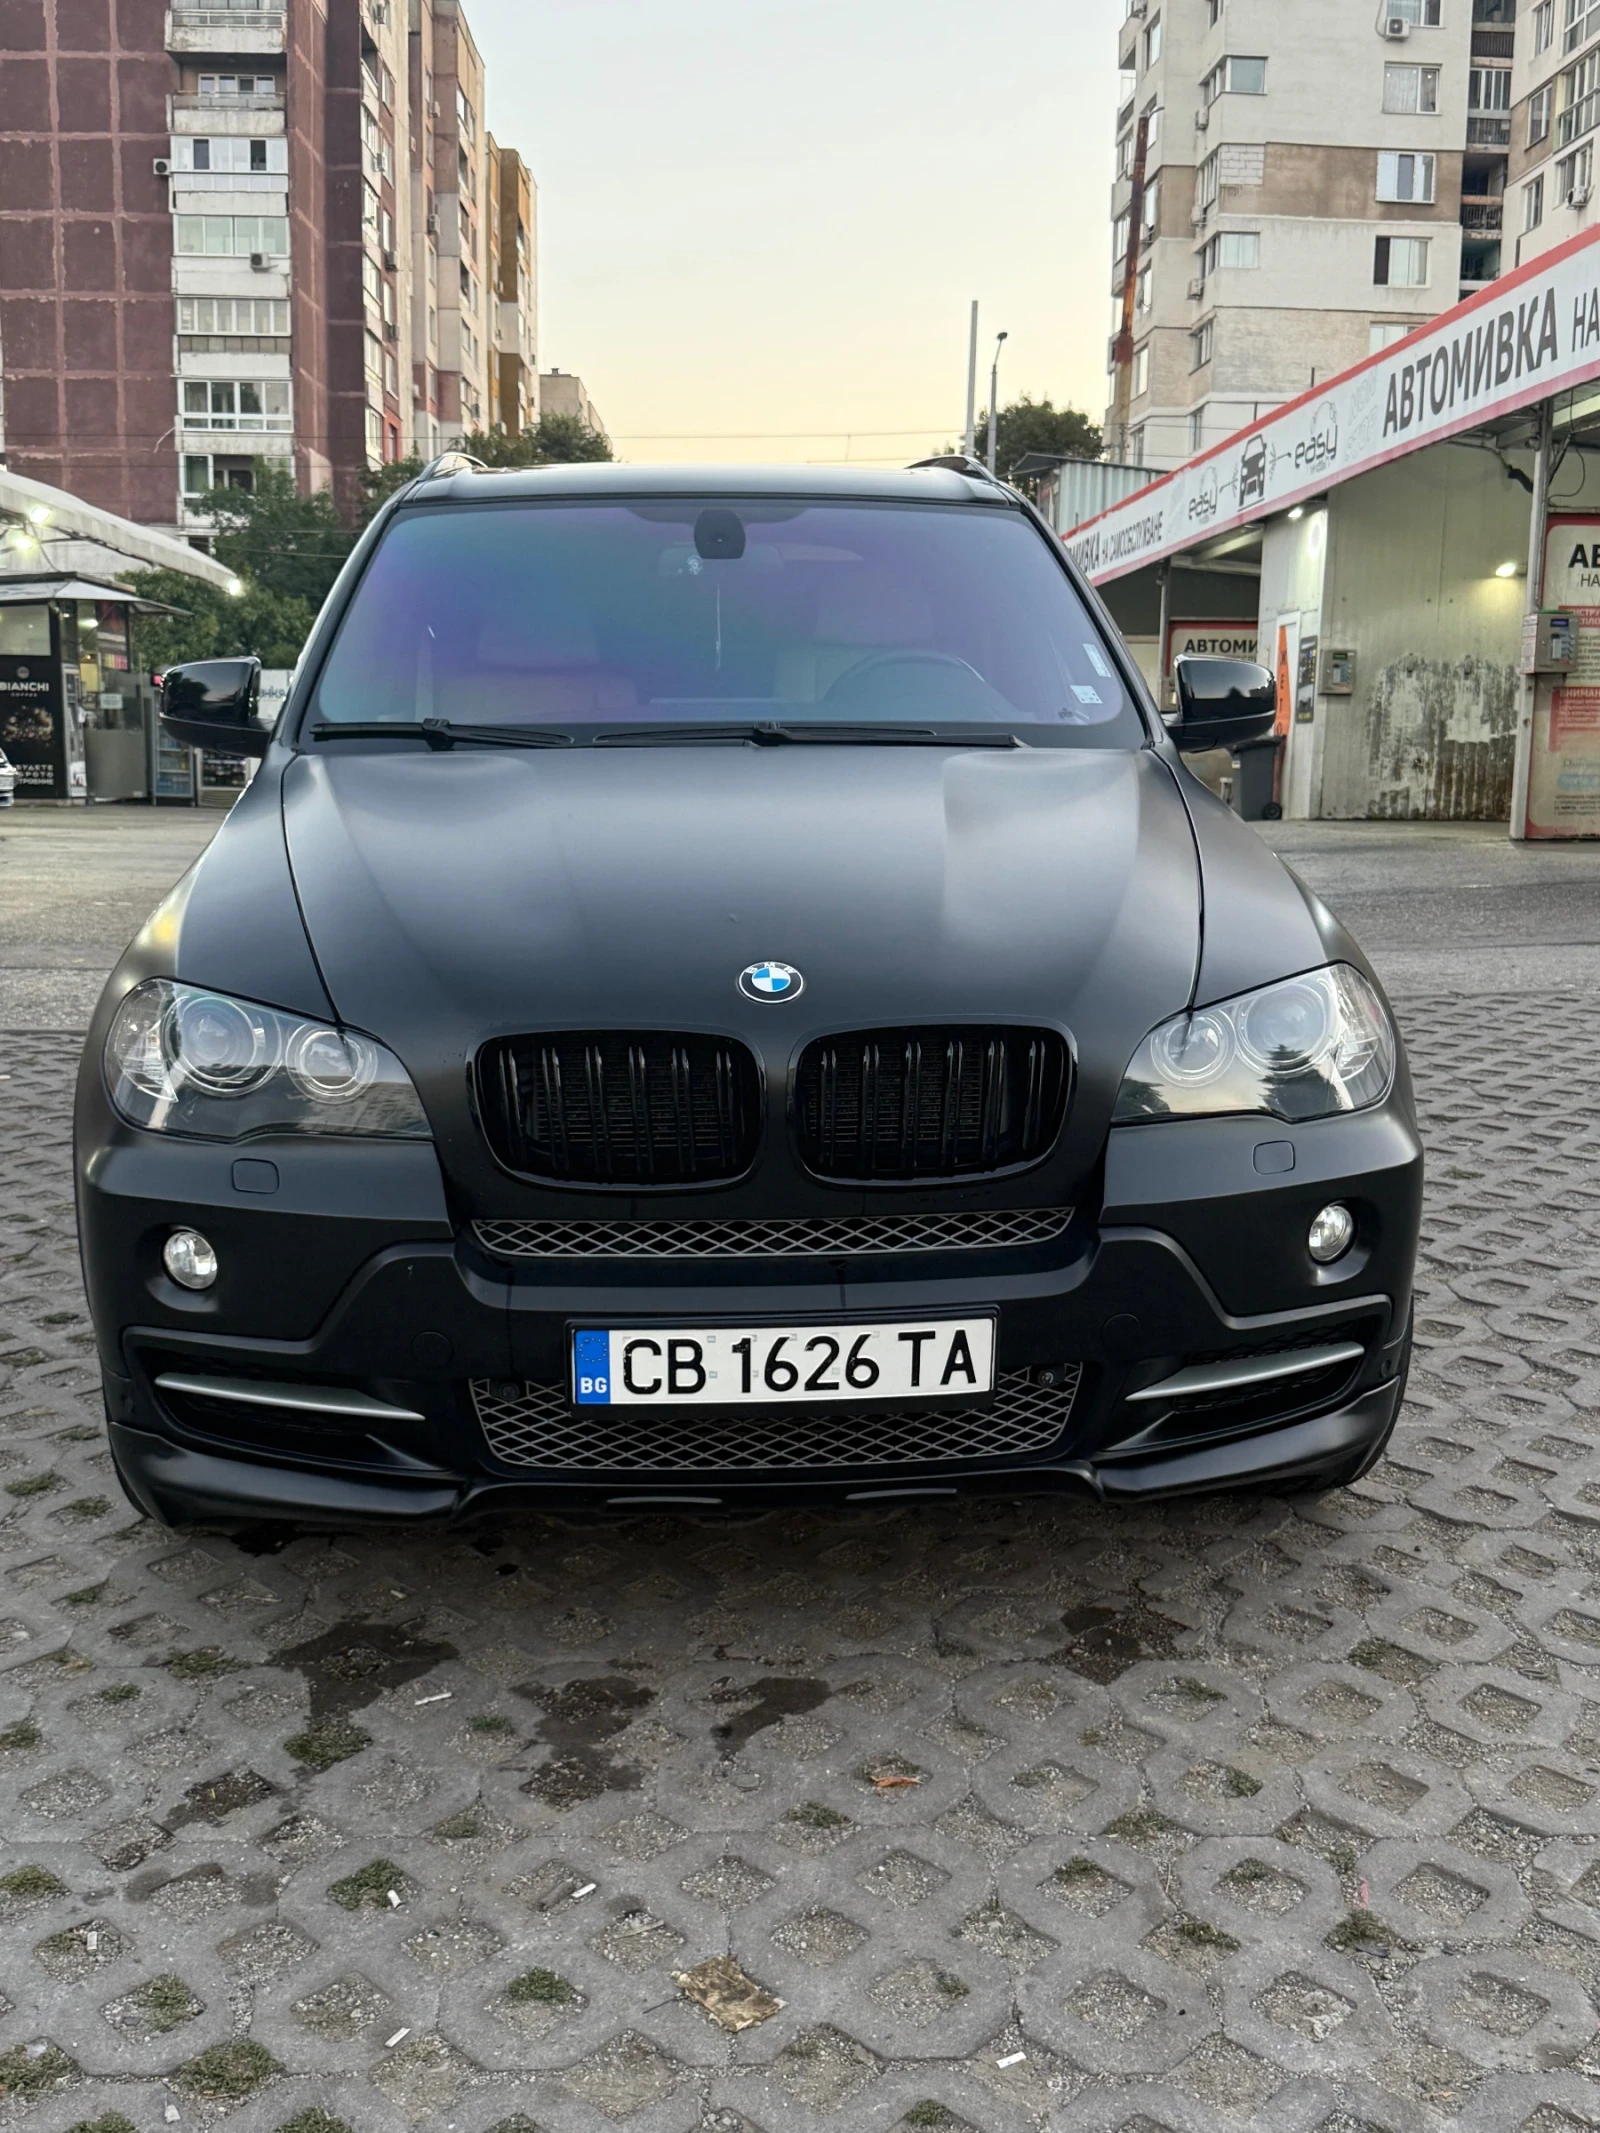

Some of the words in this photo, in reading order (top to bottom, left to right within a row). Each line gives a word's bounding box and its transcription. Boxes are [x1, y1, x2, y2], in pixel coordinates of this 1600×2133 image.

[1382, 287, 1558, 438] АВТОМИВКА
[1571, 287, 1600, 353] НА
[1294, 424, 1338, 469] easy
[1188, 486, 1218, 520] easy
[0, 681, 50, 691] BIANCHI
[731, 1333, 880, 1394] 1626
[897, 1329, 977, 1387] TA
[580, 1377, 608, 1394] BG
